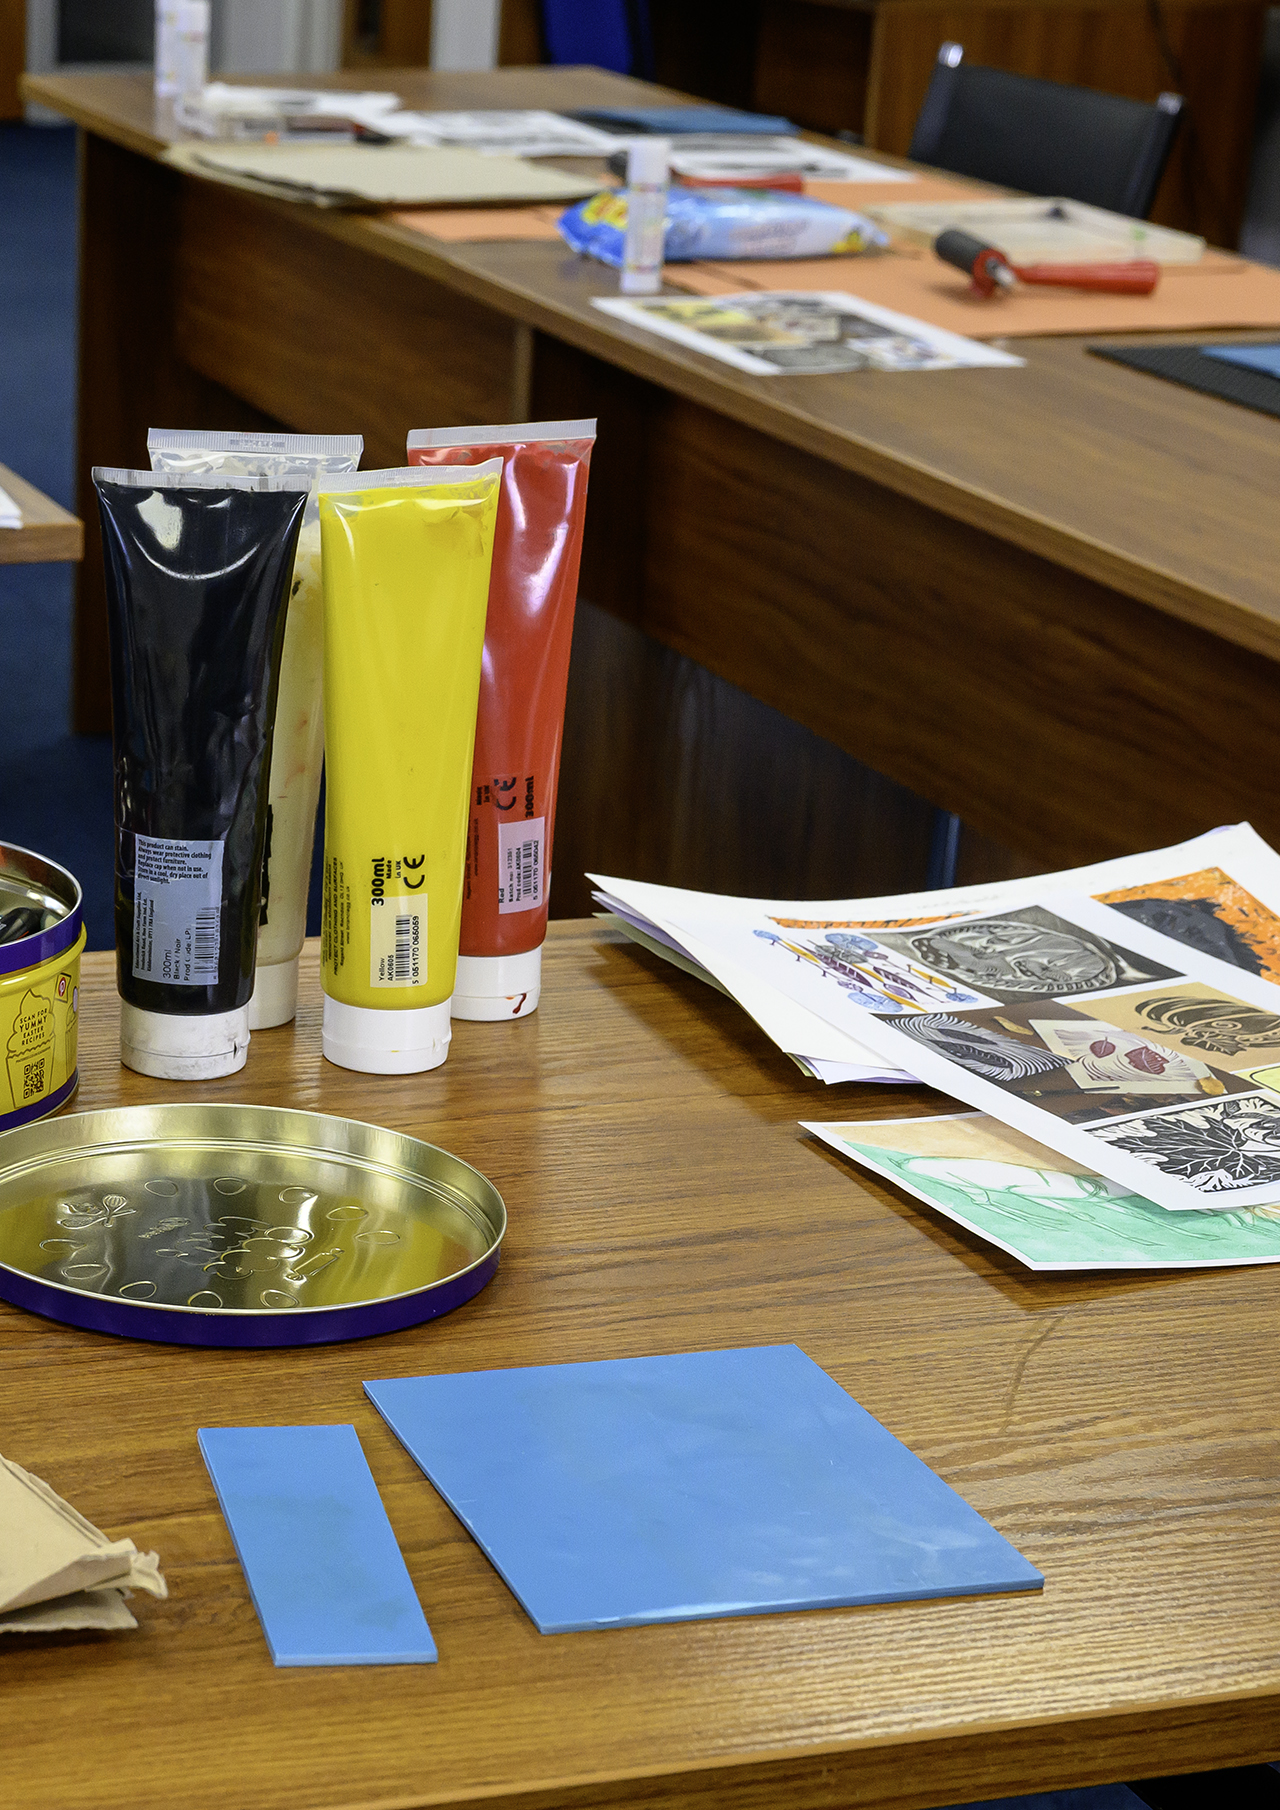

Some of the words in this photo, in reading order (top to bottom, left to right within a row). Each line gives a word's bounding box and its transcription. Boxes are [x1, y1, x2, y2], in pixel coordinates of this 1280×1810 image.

[138, 846, 152, 854] Always
[138, 860, 153, 868] Replace
[163, 857, 187, 865] furniture.
[396, 860, 401, 870] UK
[371, 857, 384, 906] 300ml
[163, 950, 171, 979] 300ml
[20, 1014, 35, 1024] SCAN
[38, 1008, 47, 1016] FOR
[20, 1015, 47, 1032] YUMMY
[22, 1032, 45, 1045] RECIPES
[23, 1025, 44, 1039] EASTER
